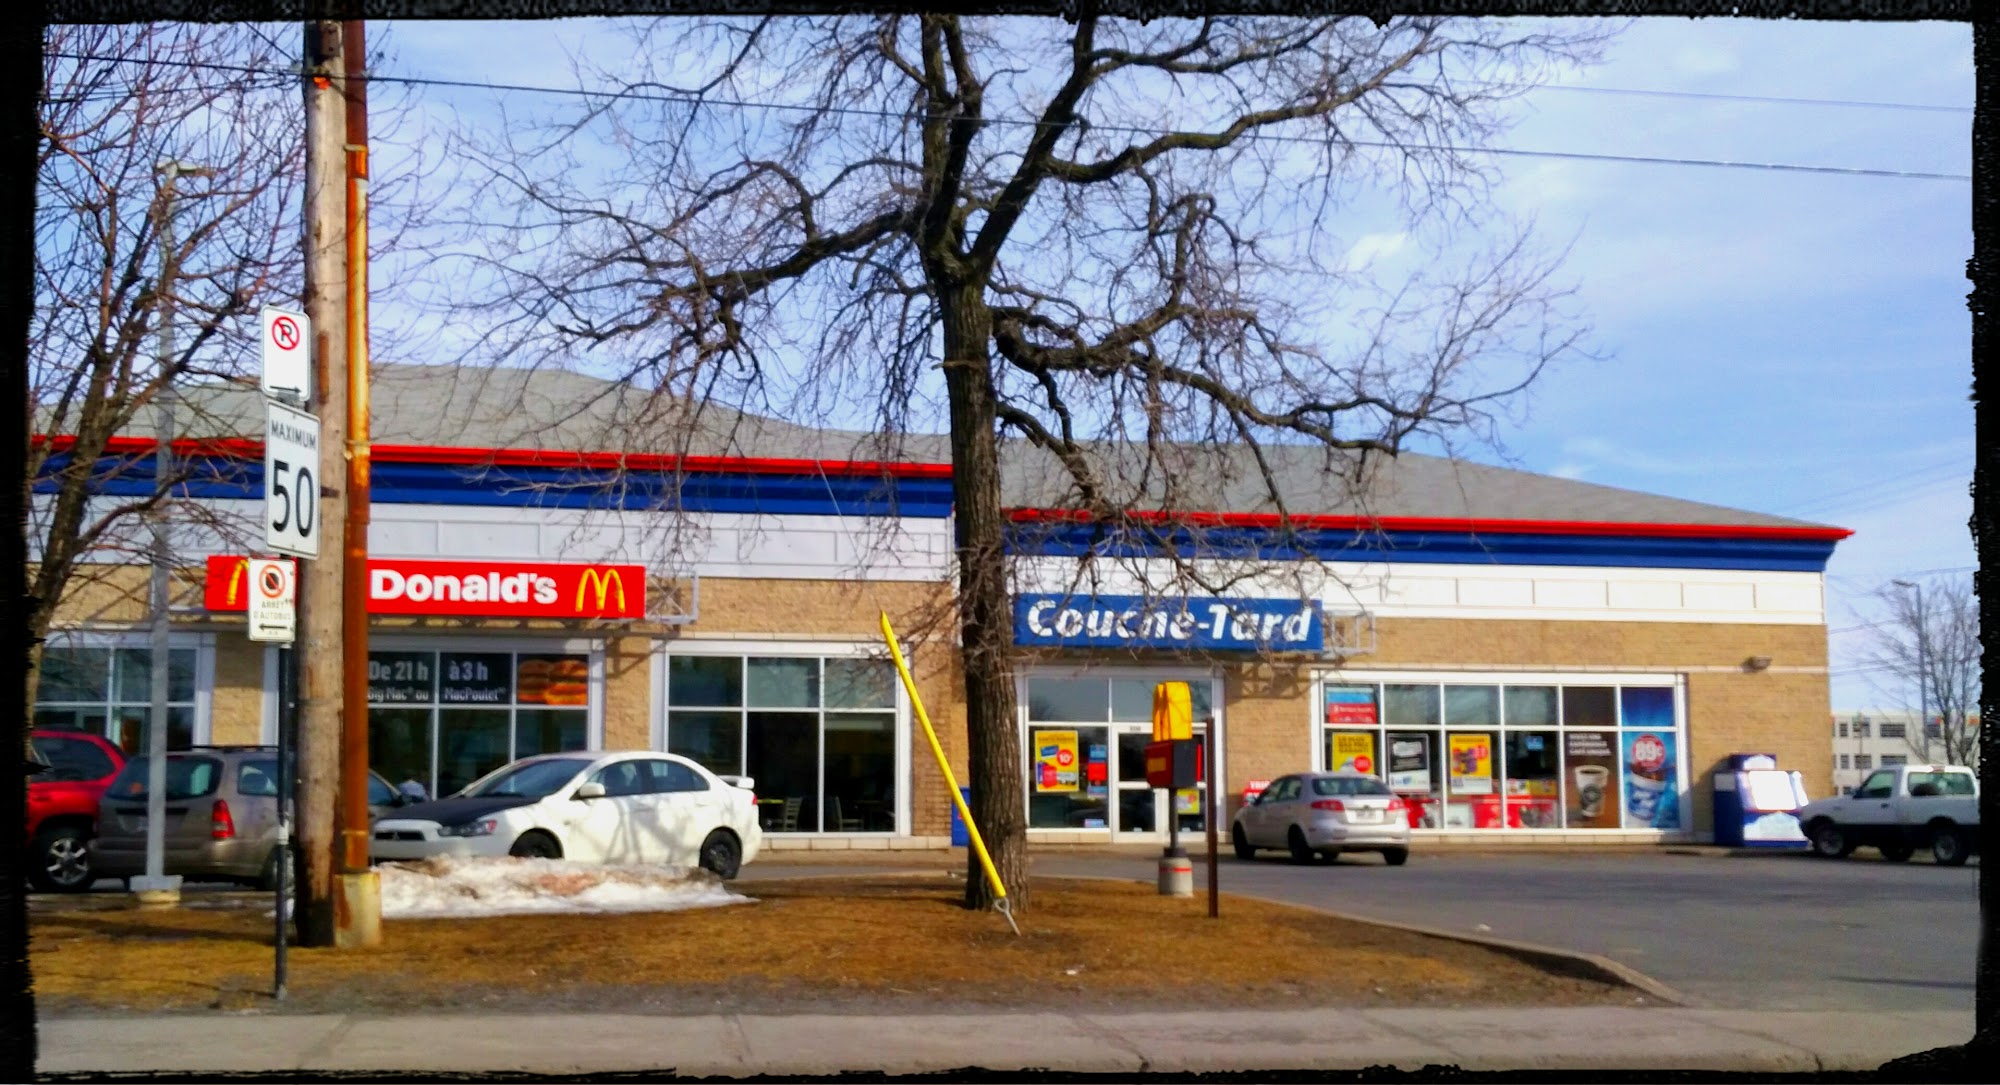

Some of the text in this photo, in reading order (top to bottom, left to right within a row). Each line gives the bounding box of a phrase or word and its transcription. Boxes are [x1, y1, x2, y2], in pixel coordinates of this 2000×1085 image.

[271, 420, 316, 449] MAXIMUM
[272, 458, 315, 538] 50
[370, 568, 558, 605] Donald's
[1027, 599, 1313, 642] Couche-Tard
[368, 660, 391, 681] De
[395, 660, 412, 681] 21
[418, 660, 428, 681] h
[462, 661, 473, 681] 3
[477, 661, 488, 681] h
